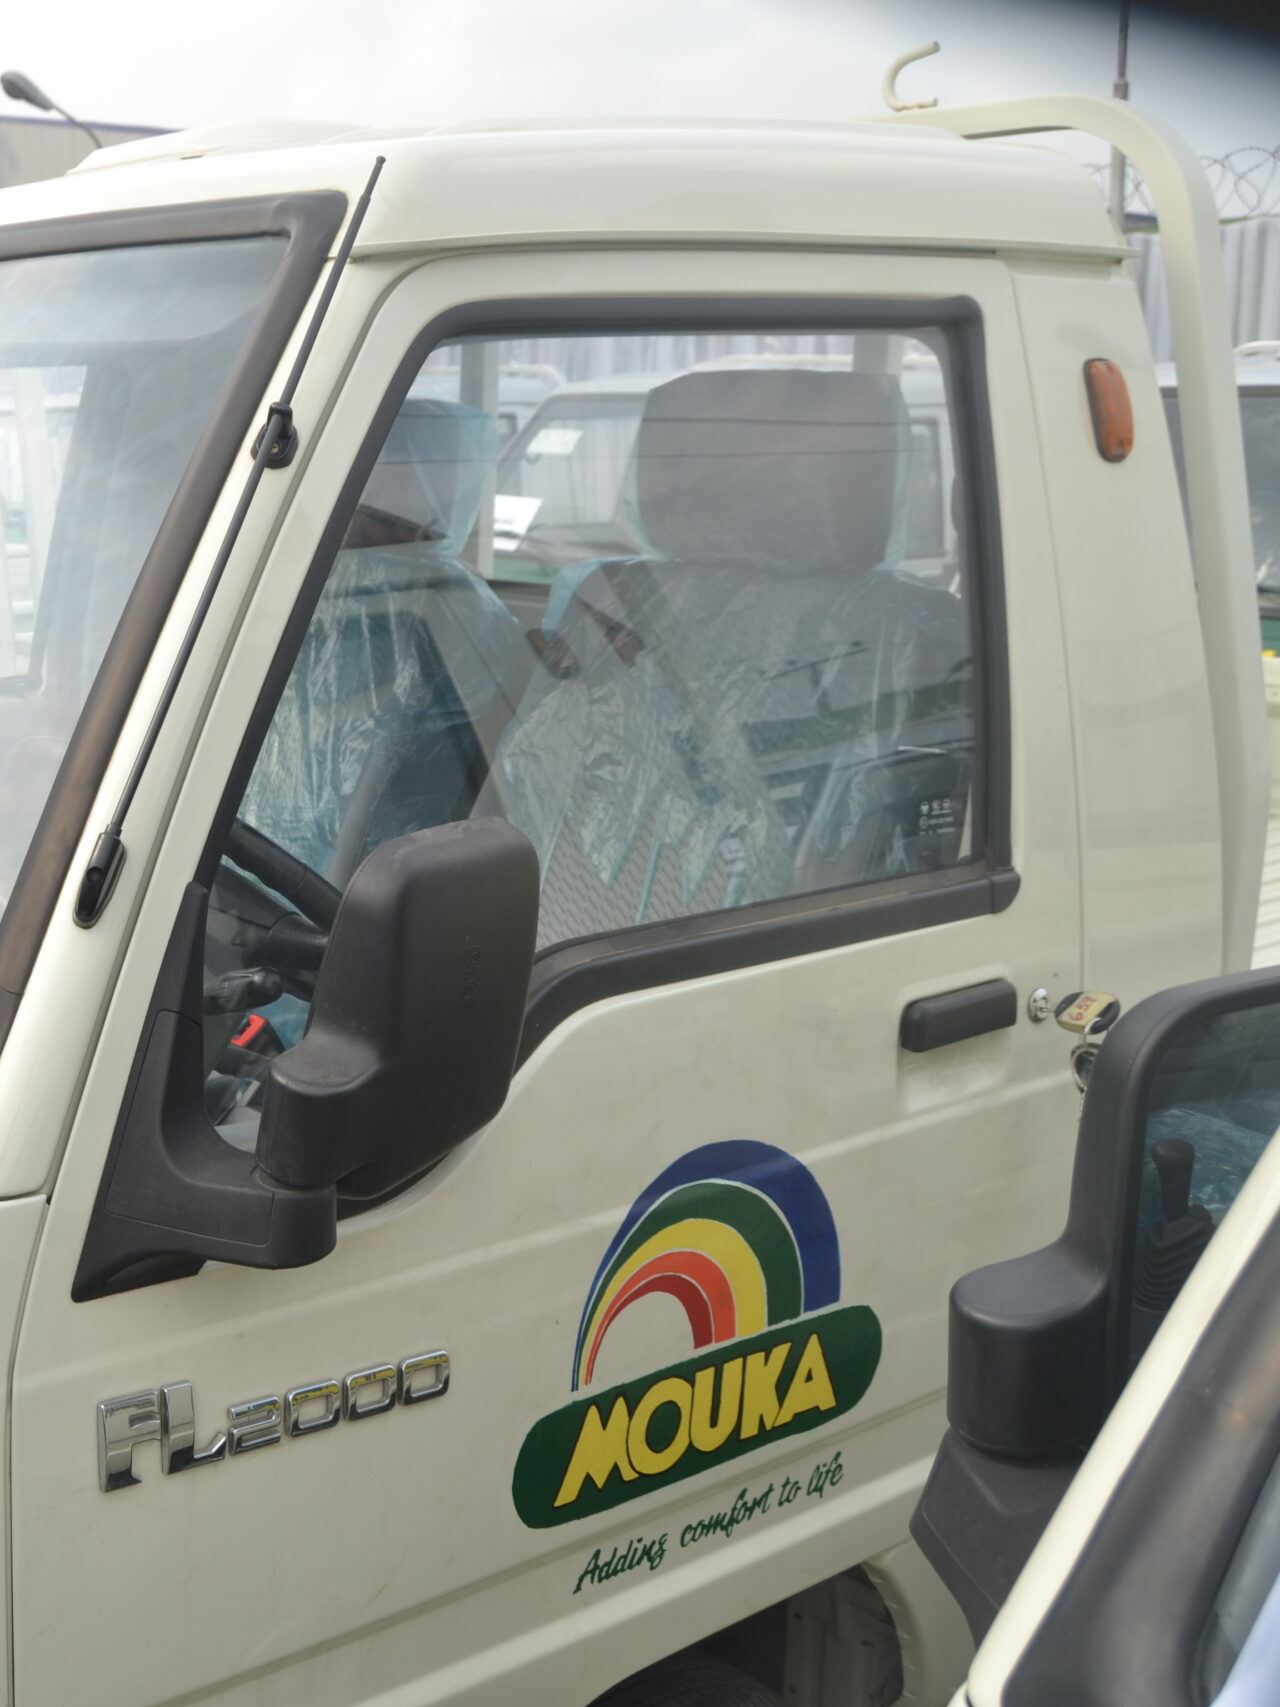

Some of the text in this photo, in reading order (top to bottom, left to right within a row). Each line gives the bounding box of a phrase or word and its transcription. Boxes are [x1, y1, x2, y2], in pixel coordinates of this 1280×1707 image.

[553, 1333, 837, 1507] MOUKA
[573, 1450, 844, 1595] Adding comfort to life
